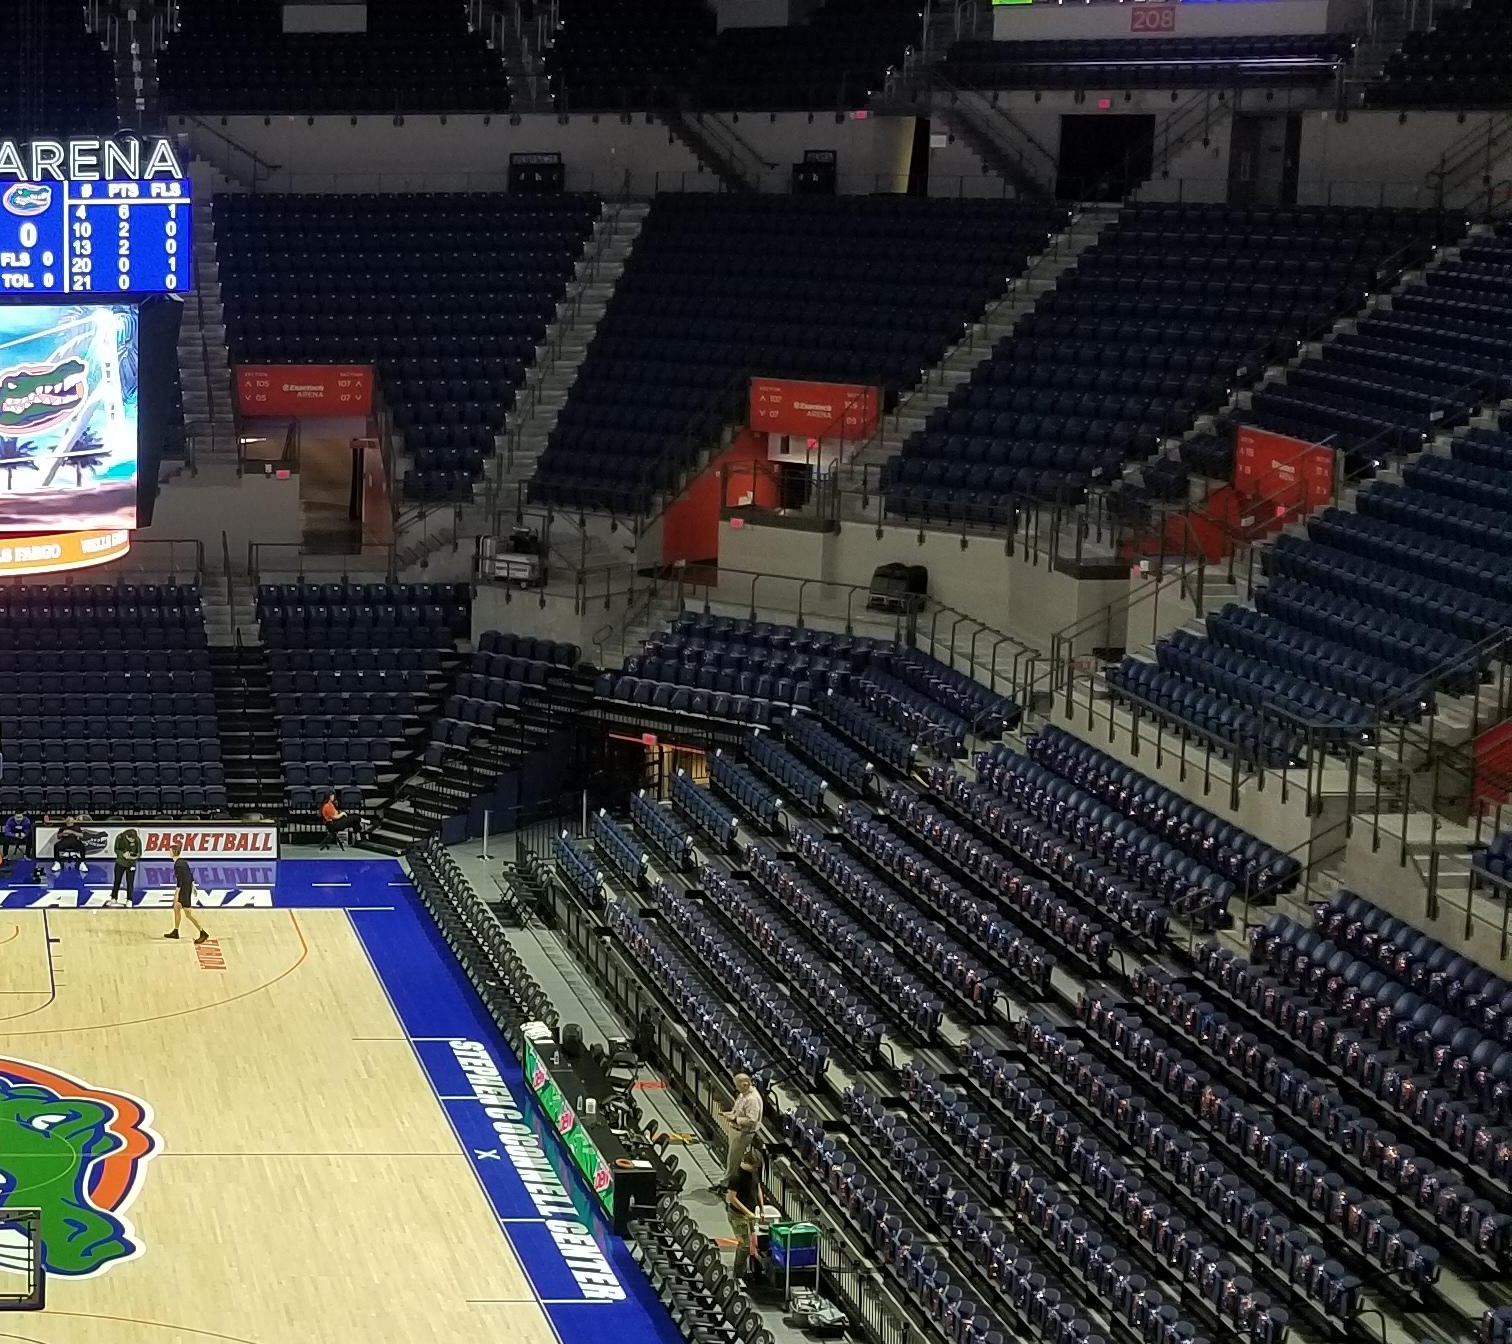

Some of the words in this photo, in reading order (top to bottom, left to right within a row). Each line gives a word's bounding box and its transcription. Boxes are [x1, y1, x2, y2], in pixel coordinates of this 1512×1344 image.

[1132, 9, 1175, 30] 208
[107, 183, 140, 198] PTS
[151, 182, 181, 197] FLS
[75, 204, 86, 220] 4
[118, 204, 129, 220] 6
[167, 203, 176, 219] 1
[19, 222, 38, 248] 0
[72, 222, 92, 238] 10
[118, 221, 129, 237] 2
[165, 220, 177, 237] 0
[72, 239, 92, 255] 13
[118, 239, 129, 255] 2
[165, 238, 177, 254] 0
[0, 252, 31, 267] FLS
[42, 251, 54, 267] 0
[72, 257, 92, 273] 20
[118, 257, 130, 272] 0
[168, 256, 176, 272] 1
[1, 273, 34, 288] TOL
[43, 272, 54, 288] 0
[72, 275, 91, 291] 21
[118, 274, 130, 290] 0
[165, 273, 177, 290] 0
[256, 380, 270, 388] 105
[337, 380, 352, 388] 107
[255, 394, 267, 402] 05
[340, 394, 351, 402] 07
[144, 832, 273, 852] BASKETBALL
[449, 1040, 518, 1108] STEPHEN
[492, 1120, 580, 1217] O'CONNELL
[545, 1220, 627, 1300] CENTER
